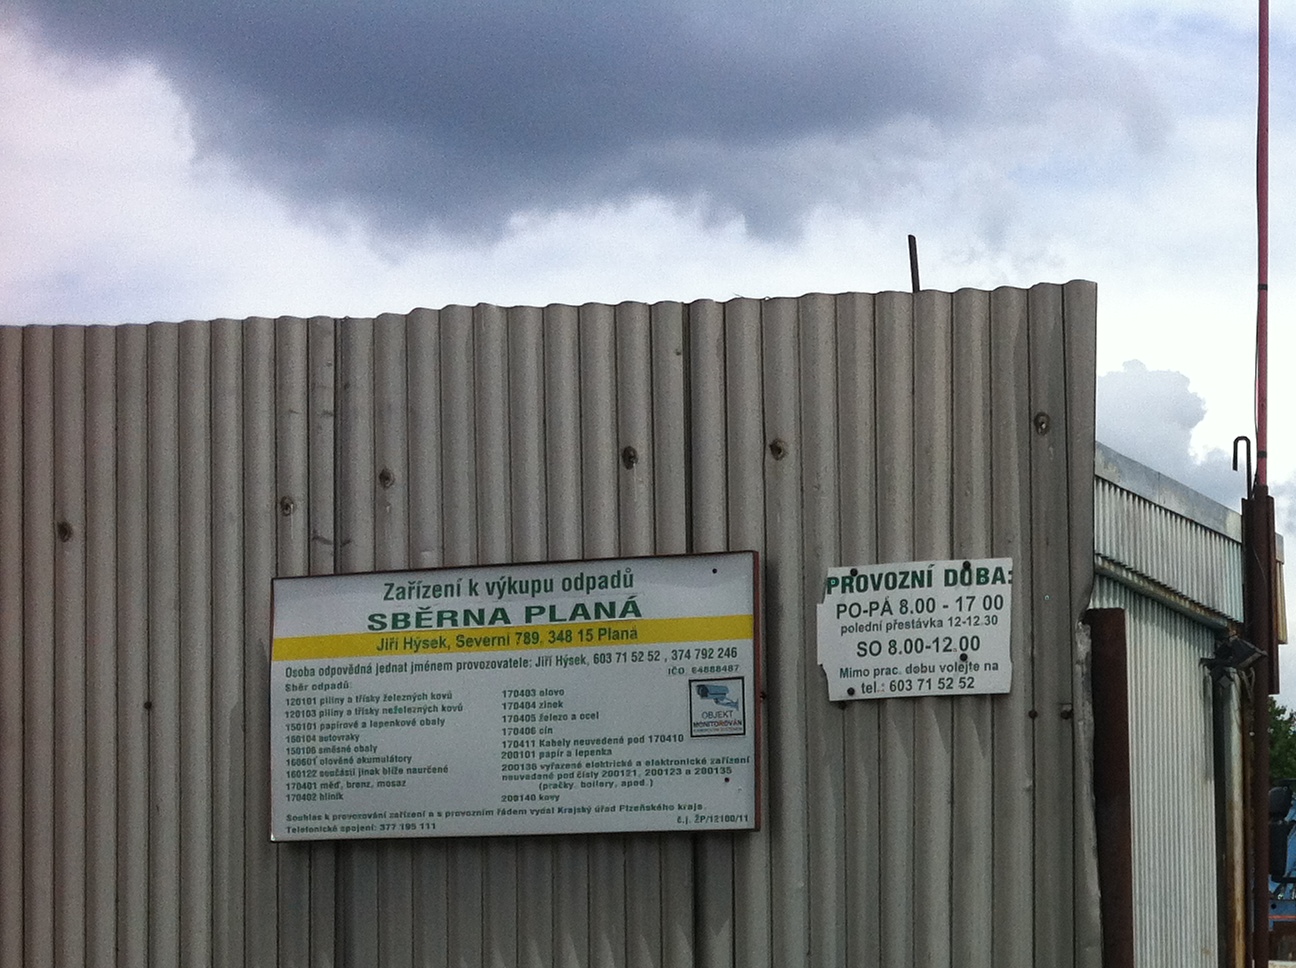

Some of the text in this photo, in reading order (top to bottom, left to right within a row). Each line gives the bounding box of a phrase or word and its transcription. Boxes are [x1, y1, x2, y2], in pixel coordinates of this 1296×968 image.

[384, 567, 634, 601] Zařízení k výkupu odpadů
[826, 564, 1013, 595] PROVOZNÍ DOBA:
[367, 596, 642, 631] SBĚRNA PLANÁ
[836, 596, 893, 619] PO-PÁ
[899, 597, 936, 615] 8.00
[840, 620, 882, 636] polední
[885, 617, 943, 633] přestávka
[376, 636, 399, 651] Jiří
[403, 636, 451, 653] Hýsek,
[548, 629, 572, 644] 348
[578, 628, 594, 642] 15
[598, 625, 638, 641] Planá
[856, 635, 980, 657] SO 8.00-12.00
[285, 647, 738, 679] Osoba odpovědná jednat jménem provozovatele: Jiří Hýsek, 603 71 52 52 374 792 246
[839, 660, 999, 679] Mimo prac. dobu volejte na
[668, 665, 685, 675] IČO
[285, 683, 309, 692] Sběr
[889, 679, 913, 692] 603
[917, 677, 933, 691] 71
[937, 677, 954, 690] 52
[958, 676, 975, 689] 52
[285, 697, 317, 706] 120101
[355, 694, 380, 704] třísky
[383, 691, 428, 702] železných
[431, 690, 453, 700] kovů
[501, 688, 565, 698] 170403 olovo
[285, 709, 317, 719] 120103
[355, 706, 380, 716] třísky
[382, 704, 438, 715] neželezných
[441, 703, 463, 712] kovů
[501, 700, 564, 710] 170404 zinek
[501, 714, 537, 723] 170405
[539, 712, 568, 722] železo
[579, 711, 599, 720] ocel
[702, 710, 733, 719] OBJEKT
[285, 722, 317, 731] 150101
[320, 720, 359, 731] papírové
[370, 718, 416, 729] lepenkové
[419, 718, 445, 728] obaly
[539, 726, 553, 735] cín
[318, 733, 360, 743] autovraky
[501, 734, 684, 748] 170411 Kabely neuvedené pod 170410
[318, 744, 351, 754] směsné
[354, 744, 378, 753] obaly
[501, 750, 536, 759] 200101
[539, 749, 564, 760] papír
[575, 748, 612, 758] lepenka
[319, 756, 354, 766] olověné
[357, 754, 412, 764] akumulátory
[540, 761, 582, 771] vyřazené
[585, 759, 632, 768] elektrické
[645, 757, 707, 767] elektronické
[710, 755, 750, 764] zařízení
[358, 767, 380, 777] jinak
[382, 766, 404, 775] blíže
[502, 772, 554, 781] neuvedené
[557, 771, 575, 780] pod
[577, 770, 599, 779] čísly
[645, 767, 682, 776] 200123
[694, 766, 733, 776] 200135
[286, 781, 317, 790] 170401
[377, 780, 406, 788] mosaz
[286, 791, 344, 802] 170402 hliník
[539, 793, 560, 802] kovy
[286, 814, 322, 822] Souhlas
[332, 811, 387, 823] provozování
[445, 808, 494, 818] provozním
[497, 806, 527, 816] řádem
[530, 806, 555, 816] vydal
[557, 806, 592, 815] Krajský
[594, 804, 616, 813] úřad
[619, 803, 674, 812] Plzeňského
[286, 825, 337, 834] Telefonické
[379, 823, 396, 831] 377
[419, 822, 436, 830] 111
